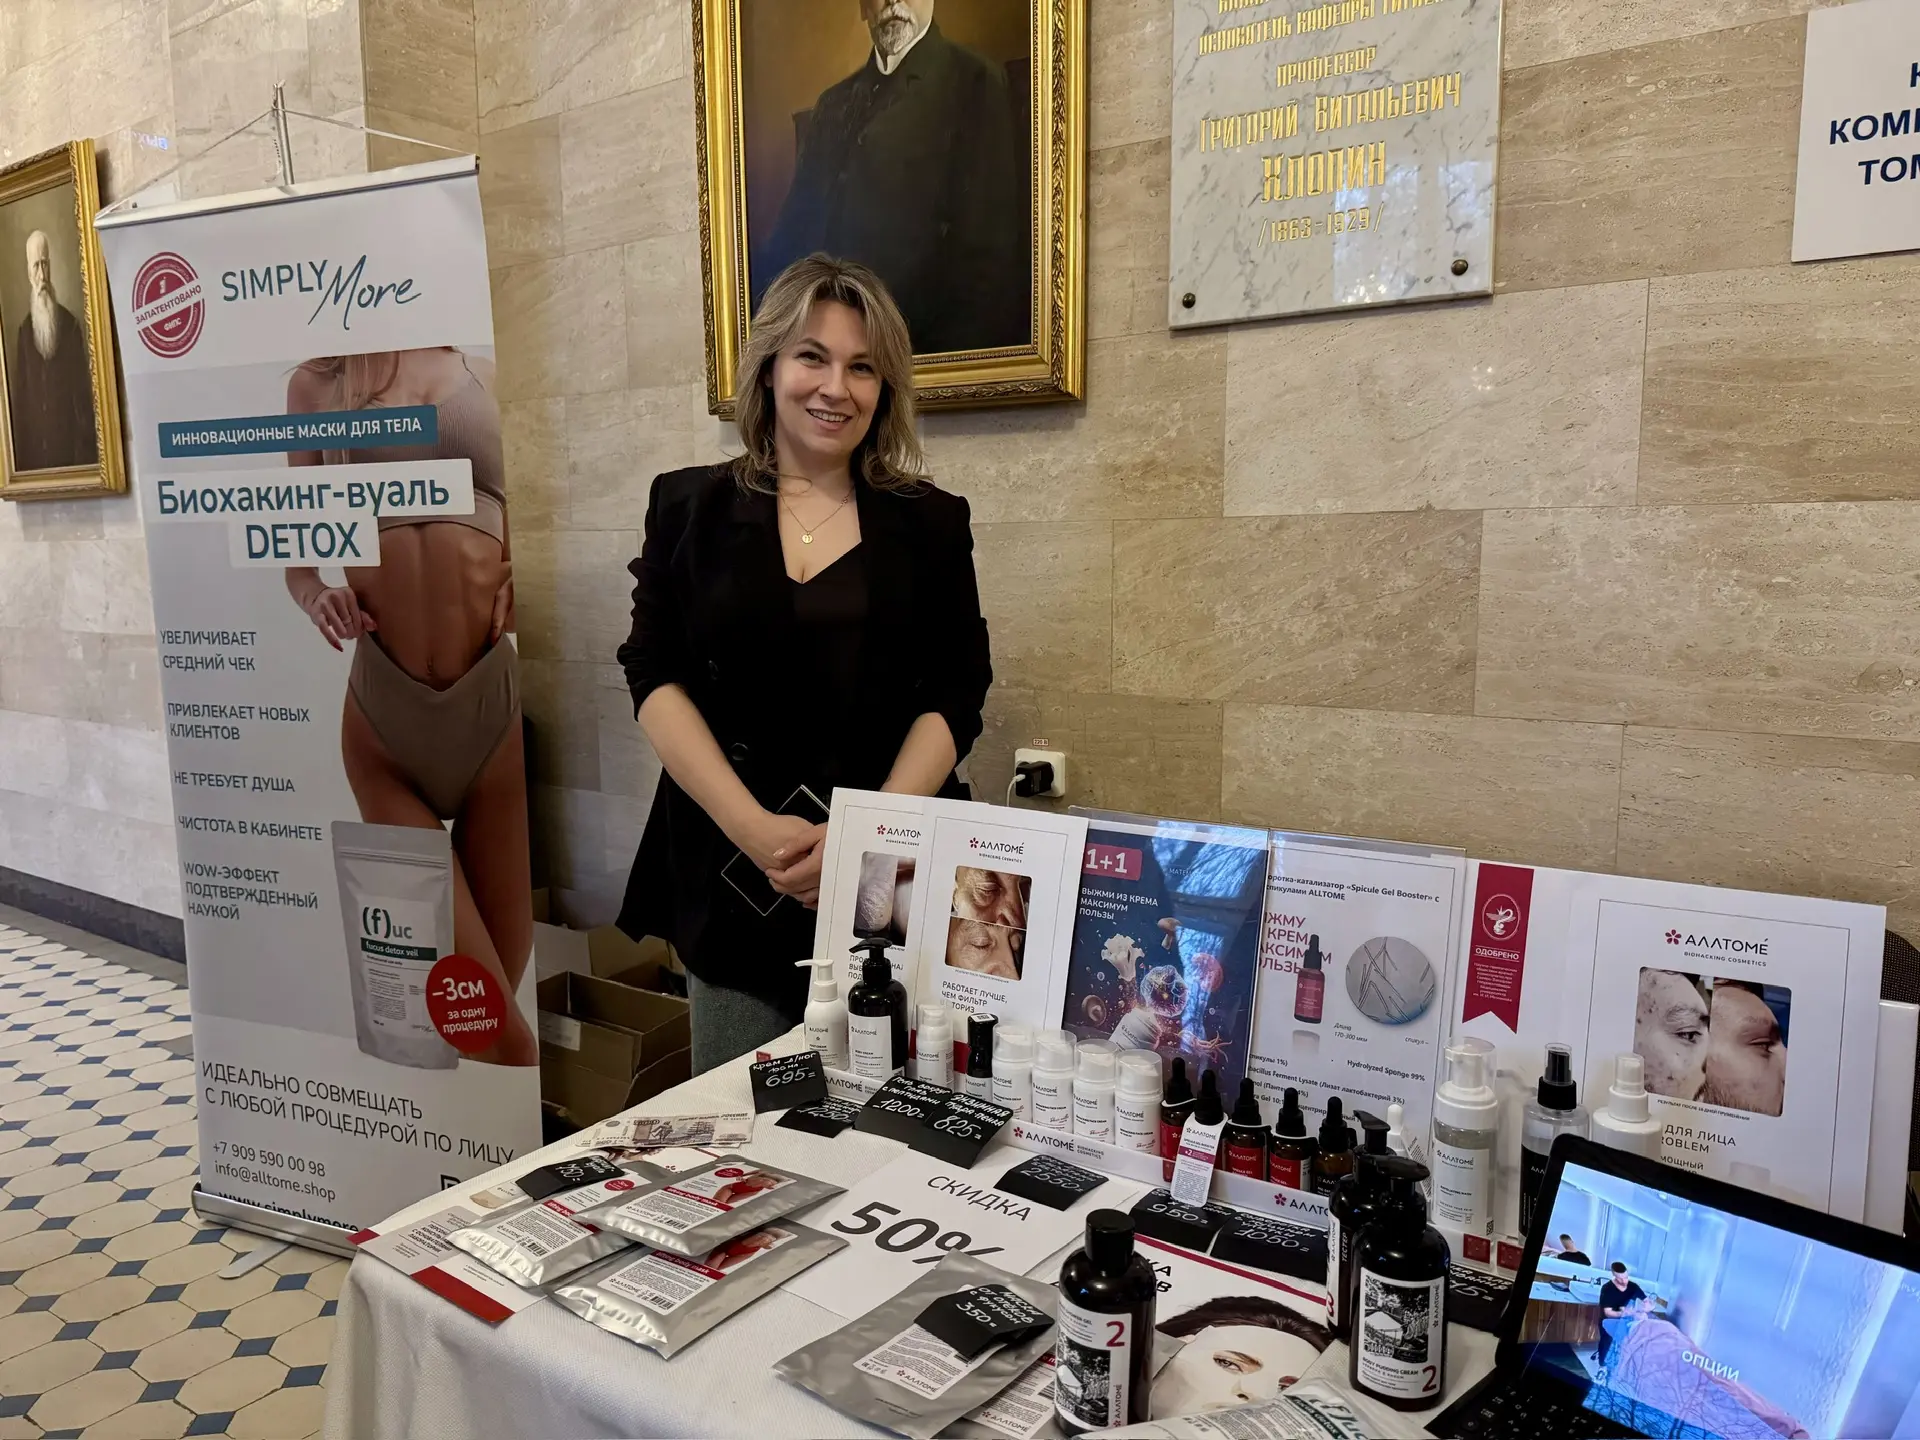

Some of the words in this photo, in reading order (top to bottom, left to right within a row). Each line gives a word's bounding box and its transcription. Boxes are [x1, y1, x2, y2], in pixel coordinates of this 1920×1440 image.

[1199, 17, 1292, 56] ОСНОВАТЕЛЬ
[1296, 1, 1375, 34] КАФЕДРЫ
[1277, 45, 1378, 87] ПРОФЕССОР
[1199, 99, 1300, 153] ГРИГОРИЙ
[1315, 71, 1462, 132] ВИТАЛЬЕВИЧ
[1260, 140, 1387, 204] ХЛОПИН
[222, 260, 328, 302] SIMPLY
[308, 254, 422, 330] More
[135, 285, 201, 325] ЗАПАТЕНТОВАНО
[164, 318, 181, 331] ФИПС
[171, 425, 295, 446] ИННОВАЦИОННЫЕ
[298, 421, 346, 438] МАСКИ
[350, 419, 381, 438] ДЛЯ
[386, 417, 422, 434] ТЕЛА
[158, 476, 450, 517] Биохакинг-вуаль
[247, 521, 361, 559] DETOX
[160, 630, 256, 646] УВЕЛИЧИВАЕТ
[163, 653, 225, 672] СРЕДНИЙ
[229, 658, 255, 671] ЧЕК
[168, 702, 255, 721] ПРИВЛЕКАЕТ
[259, 707, 310, 722] НОВЫХ
[169, 724, 240, 741] КЛИЕНТОВ
[173, 770, 189, 785] НЕ
[191, 772, 249, 790] ТРЕБУЕТ
[252, 776, 295, 792] ДУША
[178, 815, 234, 834] ЧИСТОТА
[239, 821, 247, 834] В
[251, 821, 323, 841] КАБИНЕТЕ
[1086, 847, 1128, 874] 1+1
[184, 862, 279, 884] WOW-ЭФФЕКТ
[186, 881, 318, 910] ПОДТВЕРЖДЕННЫЙ
[1081, 888, 1115, 899] ВЫЖМИ
[1116, 892, 1128, 901] ИЗ
[1130, 894, 1159, 907] КРЕМА
[1308, 889, 1345, 901] ALLTOME
[1381, 887, 1395, 896] Gel
[188, 901, 240, 921] НАУКОЙ
[1079, 907, 1115, 920] ПОЛЬЗЫ
[1080, 898, 1128, 912] МАКСИМУМ
[385, 946, 405, 956] detox
[1475, 947, 1519, 960] ОДОБРЕНО
[1684, 951, 1725, 962] BIOHACKING
[1728, 957, 1767, 967] COSMETICS
[942, 981, 978, 996] РАБОТАЕТ
[979, 987, 1008, 1004] ЛУЧШЕ,
[942, 991, 957, 1002] ЧЕМ
[958, 993, 988, 1006] ФИЛЬТР
[448, 1009, 460, 1020] за
[461, 1006, 486, 1019] одну
[443, 1018, 498, 1035] процедуру
[1277, 1058, 1288, 1067] 1%)
[1347, 1059, 1383, 1073] Hydrolyzed
[1385, 1067, 1409, 1079] Sponge
[1411, 1072, 1425, 1082] 99%
[202, 1060, 299, 1095] ИДЕАЛЬНО
[306, 1081, 423, 1120] СОВМЕЩАТЬ
[1272, 1070, 1297, 1082] Ferment
[1299, 1076, 1318, 1087] Lysate
[1319, 1081, 1340, 1091] (Лизат
[1341, 1087, 1390, 1102] лактобактерий
[1392, 1095, 1405, 1105] 3%)
[205, 1087, 216, 1104] С
[220, 1090, 286, 1119] ЛЮБОЙ
[292, 1103, 418, 1146] ПРОЦЕДУРОЙ
[424, 1131, 451, 1153] ПО
[459, 1138, 514, 1165] ЛИЦУ
[1664, 1124, 1692, 1139] ДЛЯ
[1697, 1129, 1736, 1147] ЛИЦА
[213, 1141, 227, 1156] +7
[231, 1145, 255, 1163] 909
[259, 1150, 284, 1167] 590
[288, 1156, 305, 1171] 00
[309, 1160, 326, 1177] 98
[215, 1161, 336, 1203] info@alltome.shop
[927, 1175, 1032, 1222] СКИДКА
[830, 1201, 1005, 1266] 50%
[1106, 1321, 1125, 1347] 2
[1681, 1349, 1741, 1382] ОПЦИИ
[1422, 1365, 1437, 1392] 2
